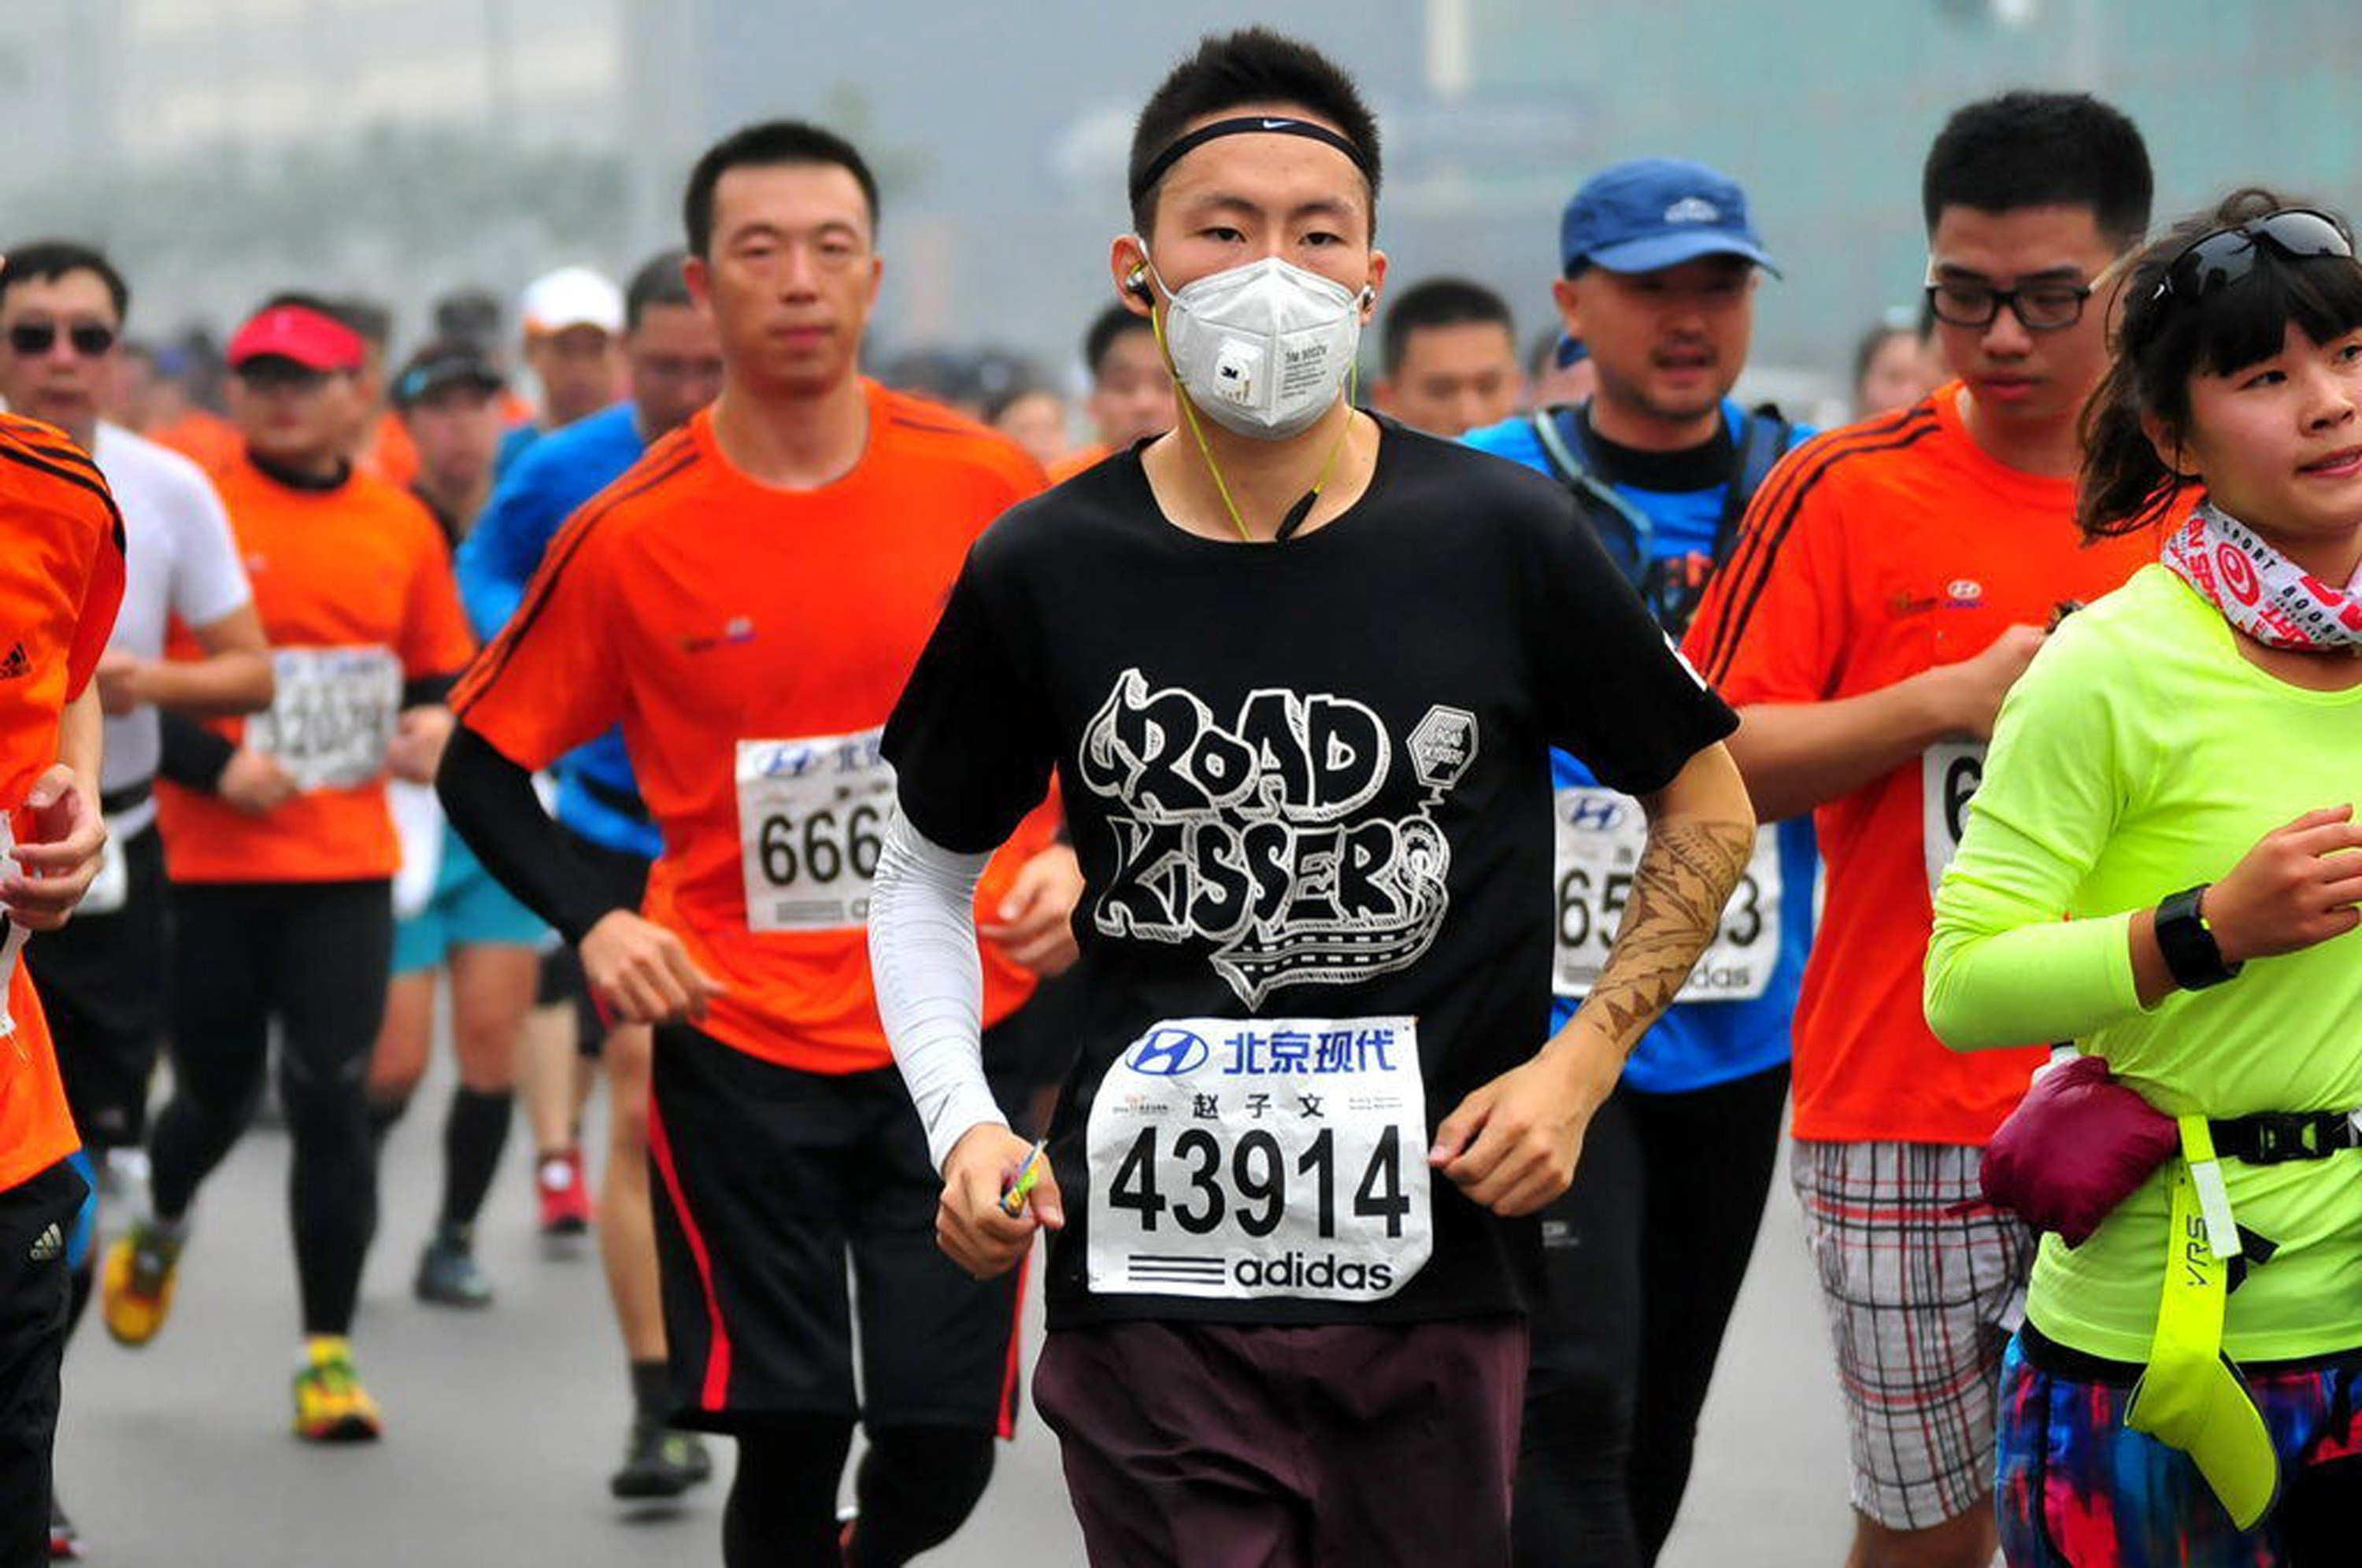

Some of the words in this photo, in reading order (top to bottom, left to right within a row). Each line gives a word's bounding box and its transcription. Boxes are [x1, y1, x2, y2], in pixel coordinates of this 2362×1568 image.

[1223, 1030, 1398, 1076] 北京现代
[1109, 1125, 1411, 1239] 43914
[1234, 1251, 1394, 1291] adidas
